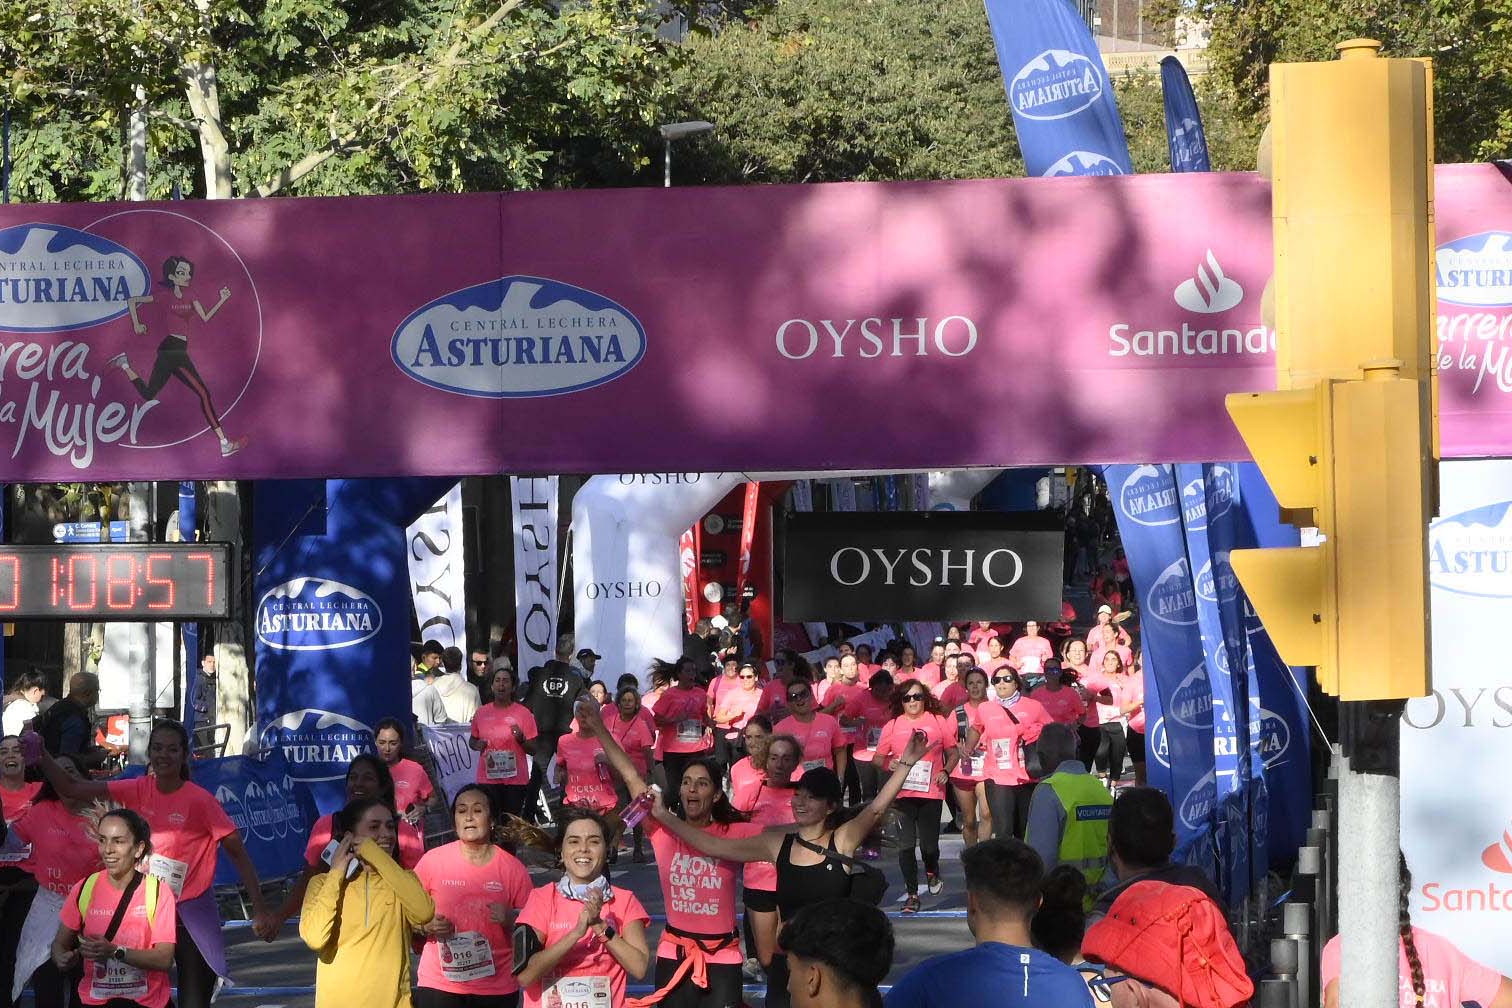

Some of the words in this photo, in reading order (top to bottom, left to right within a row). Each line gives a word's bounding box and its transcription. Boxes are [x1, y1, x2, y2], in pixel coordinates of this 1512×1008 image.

[53, 259, 125, 271] LECHERA
[450, 318, 529, 331] CENTRAL
[537, 316, 617, 328] LECHERA
[412, 324, 625, 366] ASTURIANA
[775, 316, 977, 358] OYSHO
[13, 377, 160, 468] Mujer
[830, 547, 1022, 588] OYSHO
[587, 581, 661, 599] OYSHO
[261, 604, 372, 634] ASTURIANA
[549, 680, 563, 691] BP
[671, 886, 696, 900] LAS
[672, 900, 719, 915] CHICAS
[454, 951, 472, 961] 016
